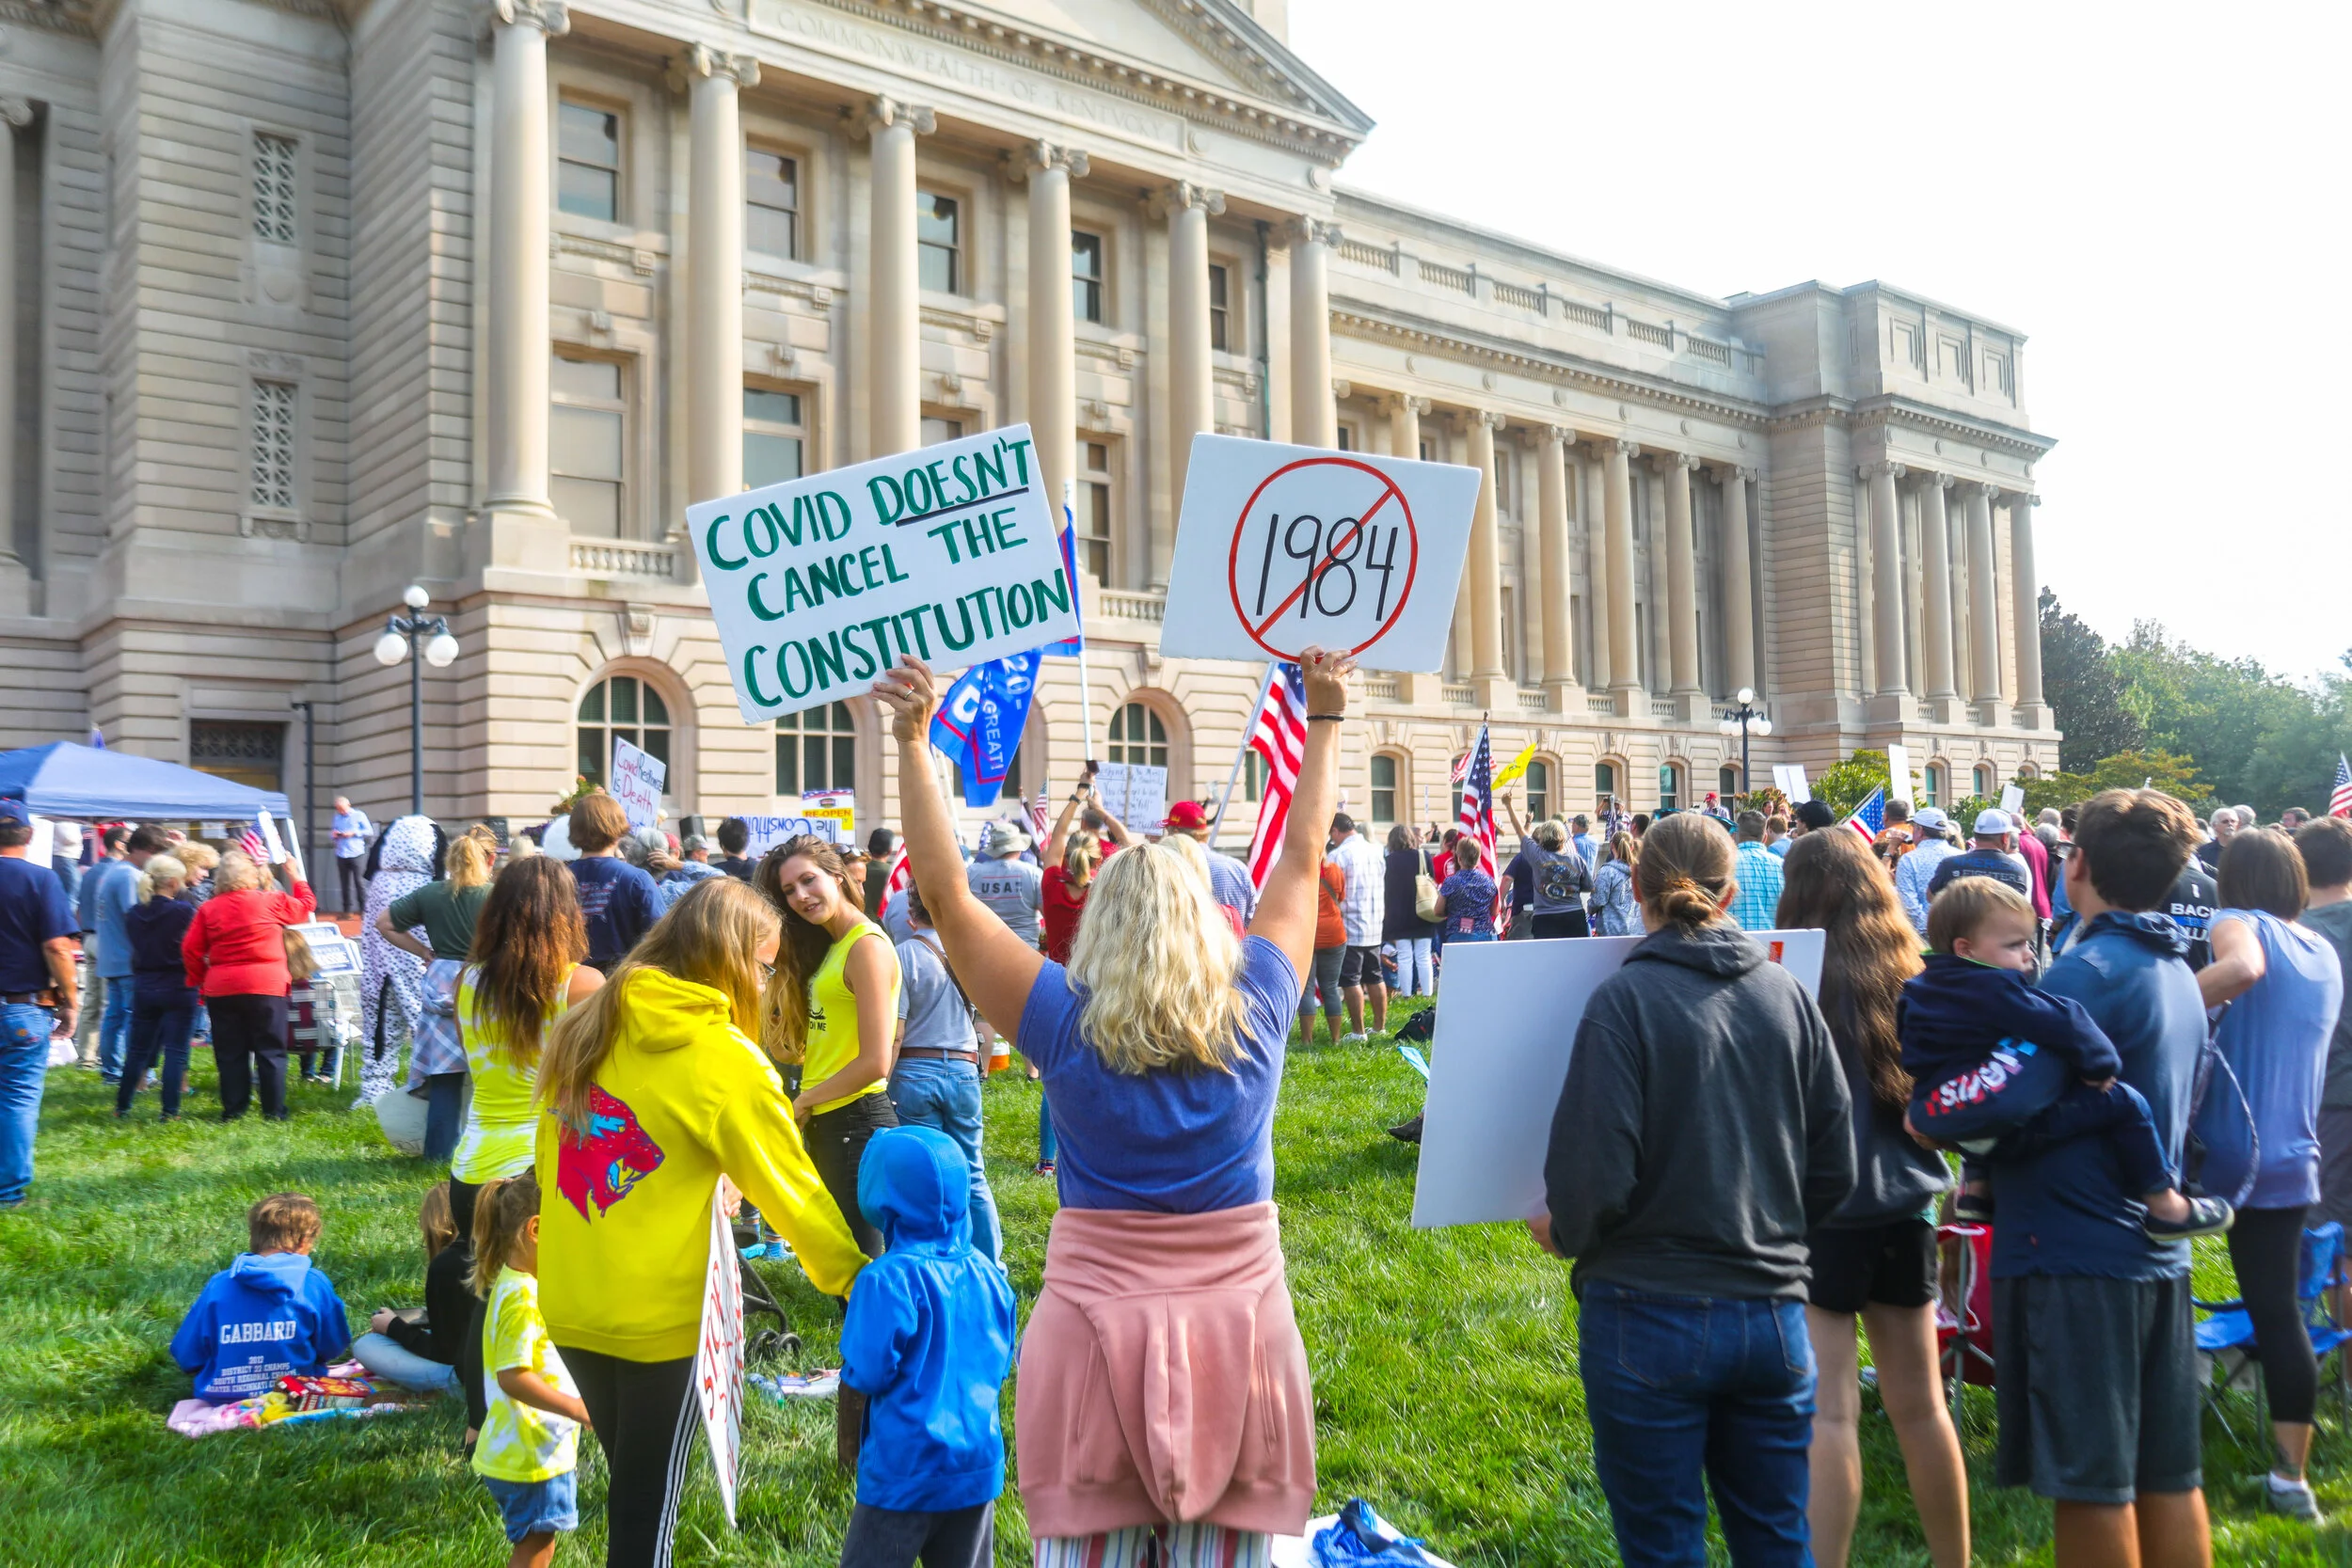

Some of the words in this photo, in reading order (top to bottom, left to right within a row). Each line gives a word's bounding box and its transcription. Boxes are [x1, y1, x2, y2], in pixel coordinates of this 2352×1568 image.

[777, 9, 995, 89] COMMONWEALTH
[1011, 79, 1040, 103] OF
[707, 491, 851, 570] COVID
[866, 436, 1030, 526] DOESN'T
[747, 544, 909, 622] CANCEL
[928, 507, 1027, 564] THE
[1256, 514, 1398, 622] 1984
[744, 568, 1070, 707] CONSTITUTION
[982, 699, 1005, 770] GREAT!
[622, 774, 653, 815] Death
[804, 809, 851, 818] RE-OPEN
[981, 881, 1012, 894] USA
[220, 1321, 297, 1344] GABBARD
[703, 1260, 723, 1421] STOP
[213, 1376, 236, 1385] SOUTH
[237, 1372, 269, 1384] REGIONAL
[221, 1366, 252, 1377] DISTRICT
[264, 1362, 290, 1371] CHAMPS
